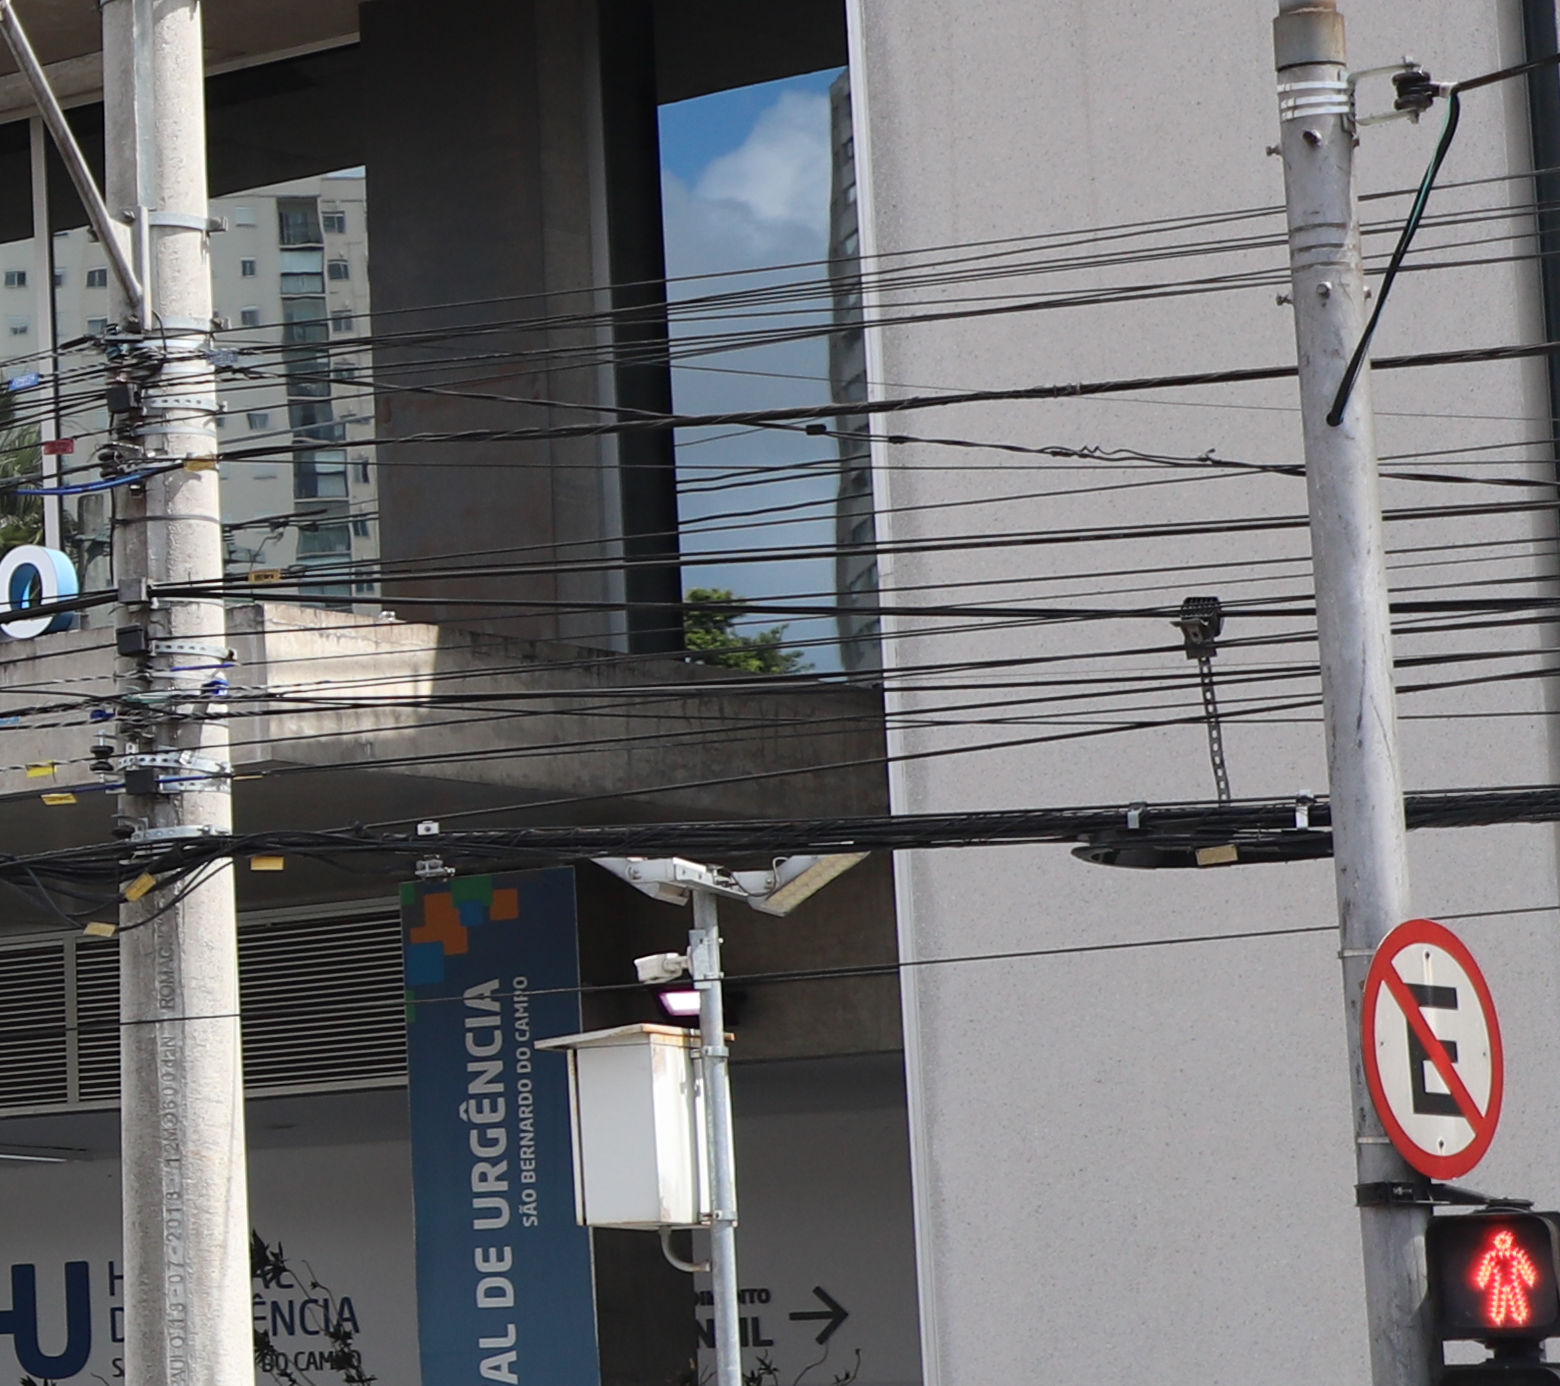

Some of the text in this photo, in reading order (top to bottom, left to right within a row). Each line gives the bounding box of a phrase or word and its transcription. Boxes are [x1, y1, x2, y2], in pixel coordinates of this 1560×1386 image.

[459, 978, 511, 1231] URGÊNCIA
[512, 975, 539, 1227] SÃO BERNARDO DO CAMPO
[1403, 982, 1470, 1119] E
[474, 1245, 515, 1309] DE
